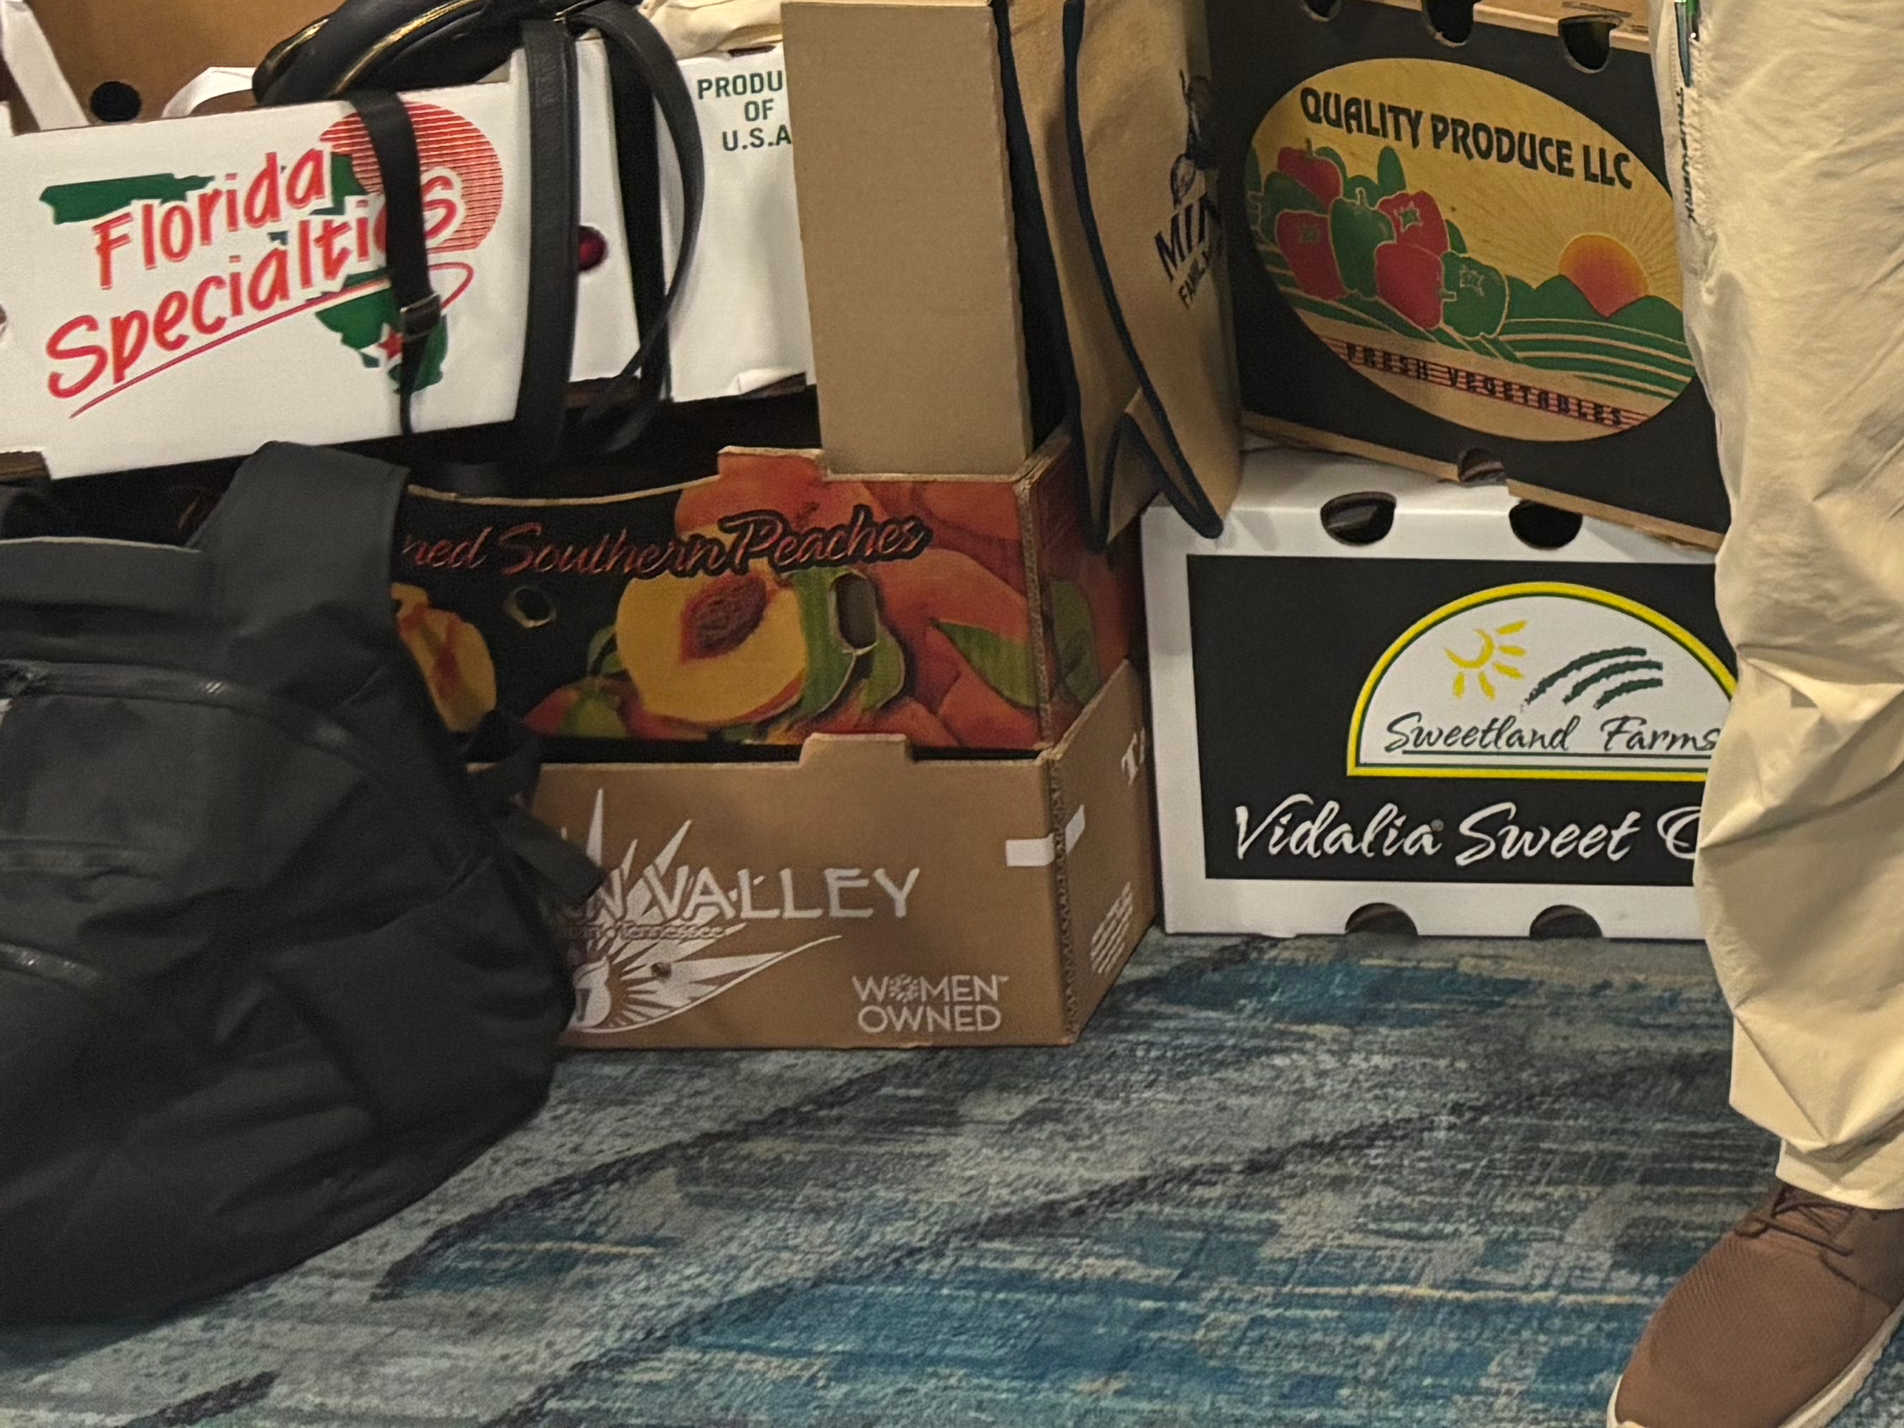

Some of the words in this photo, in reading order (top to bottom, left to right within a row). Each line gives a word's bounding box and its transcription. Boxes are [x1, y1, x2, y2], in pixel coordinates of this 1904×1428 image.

[697, 70, 784, 101] PRODU
[743, 98, 775, 122] OF
[1299, 87, 1423, 148] QUALITY
[1430, 113, 1574, 179] PRODUCE
[1581, 144, 1633, 190] LLC
[93, 148, 327, 291] Florida
[45, 172, 460, 399] Specialtis
[1346, 344, 1430, 381] FRESH
[1446, 365, 1624, 429] VEGETABLES
[499, 522, 727, 576] Southern
[721, 507, 926, 571] Peaches
[1383, 711, 1581, 755] Sweetland
[1600, 715, 1721, 755] Farms
[1235, 793, 1443, 860] Vidalia
[1454, 801, 1643, 867] Sweet
[643, 864, 921, 920] VALLEY
[858, 1003, 1001, 1033] OWNED
